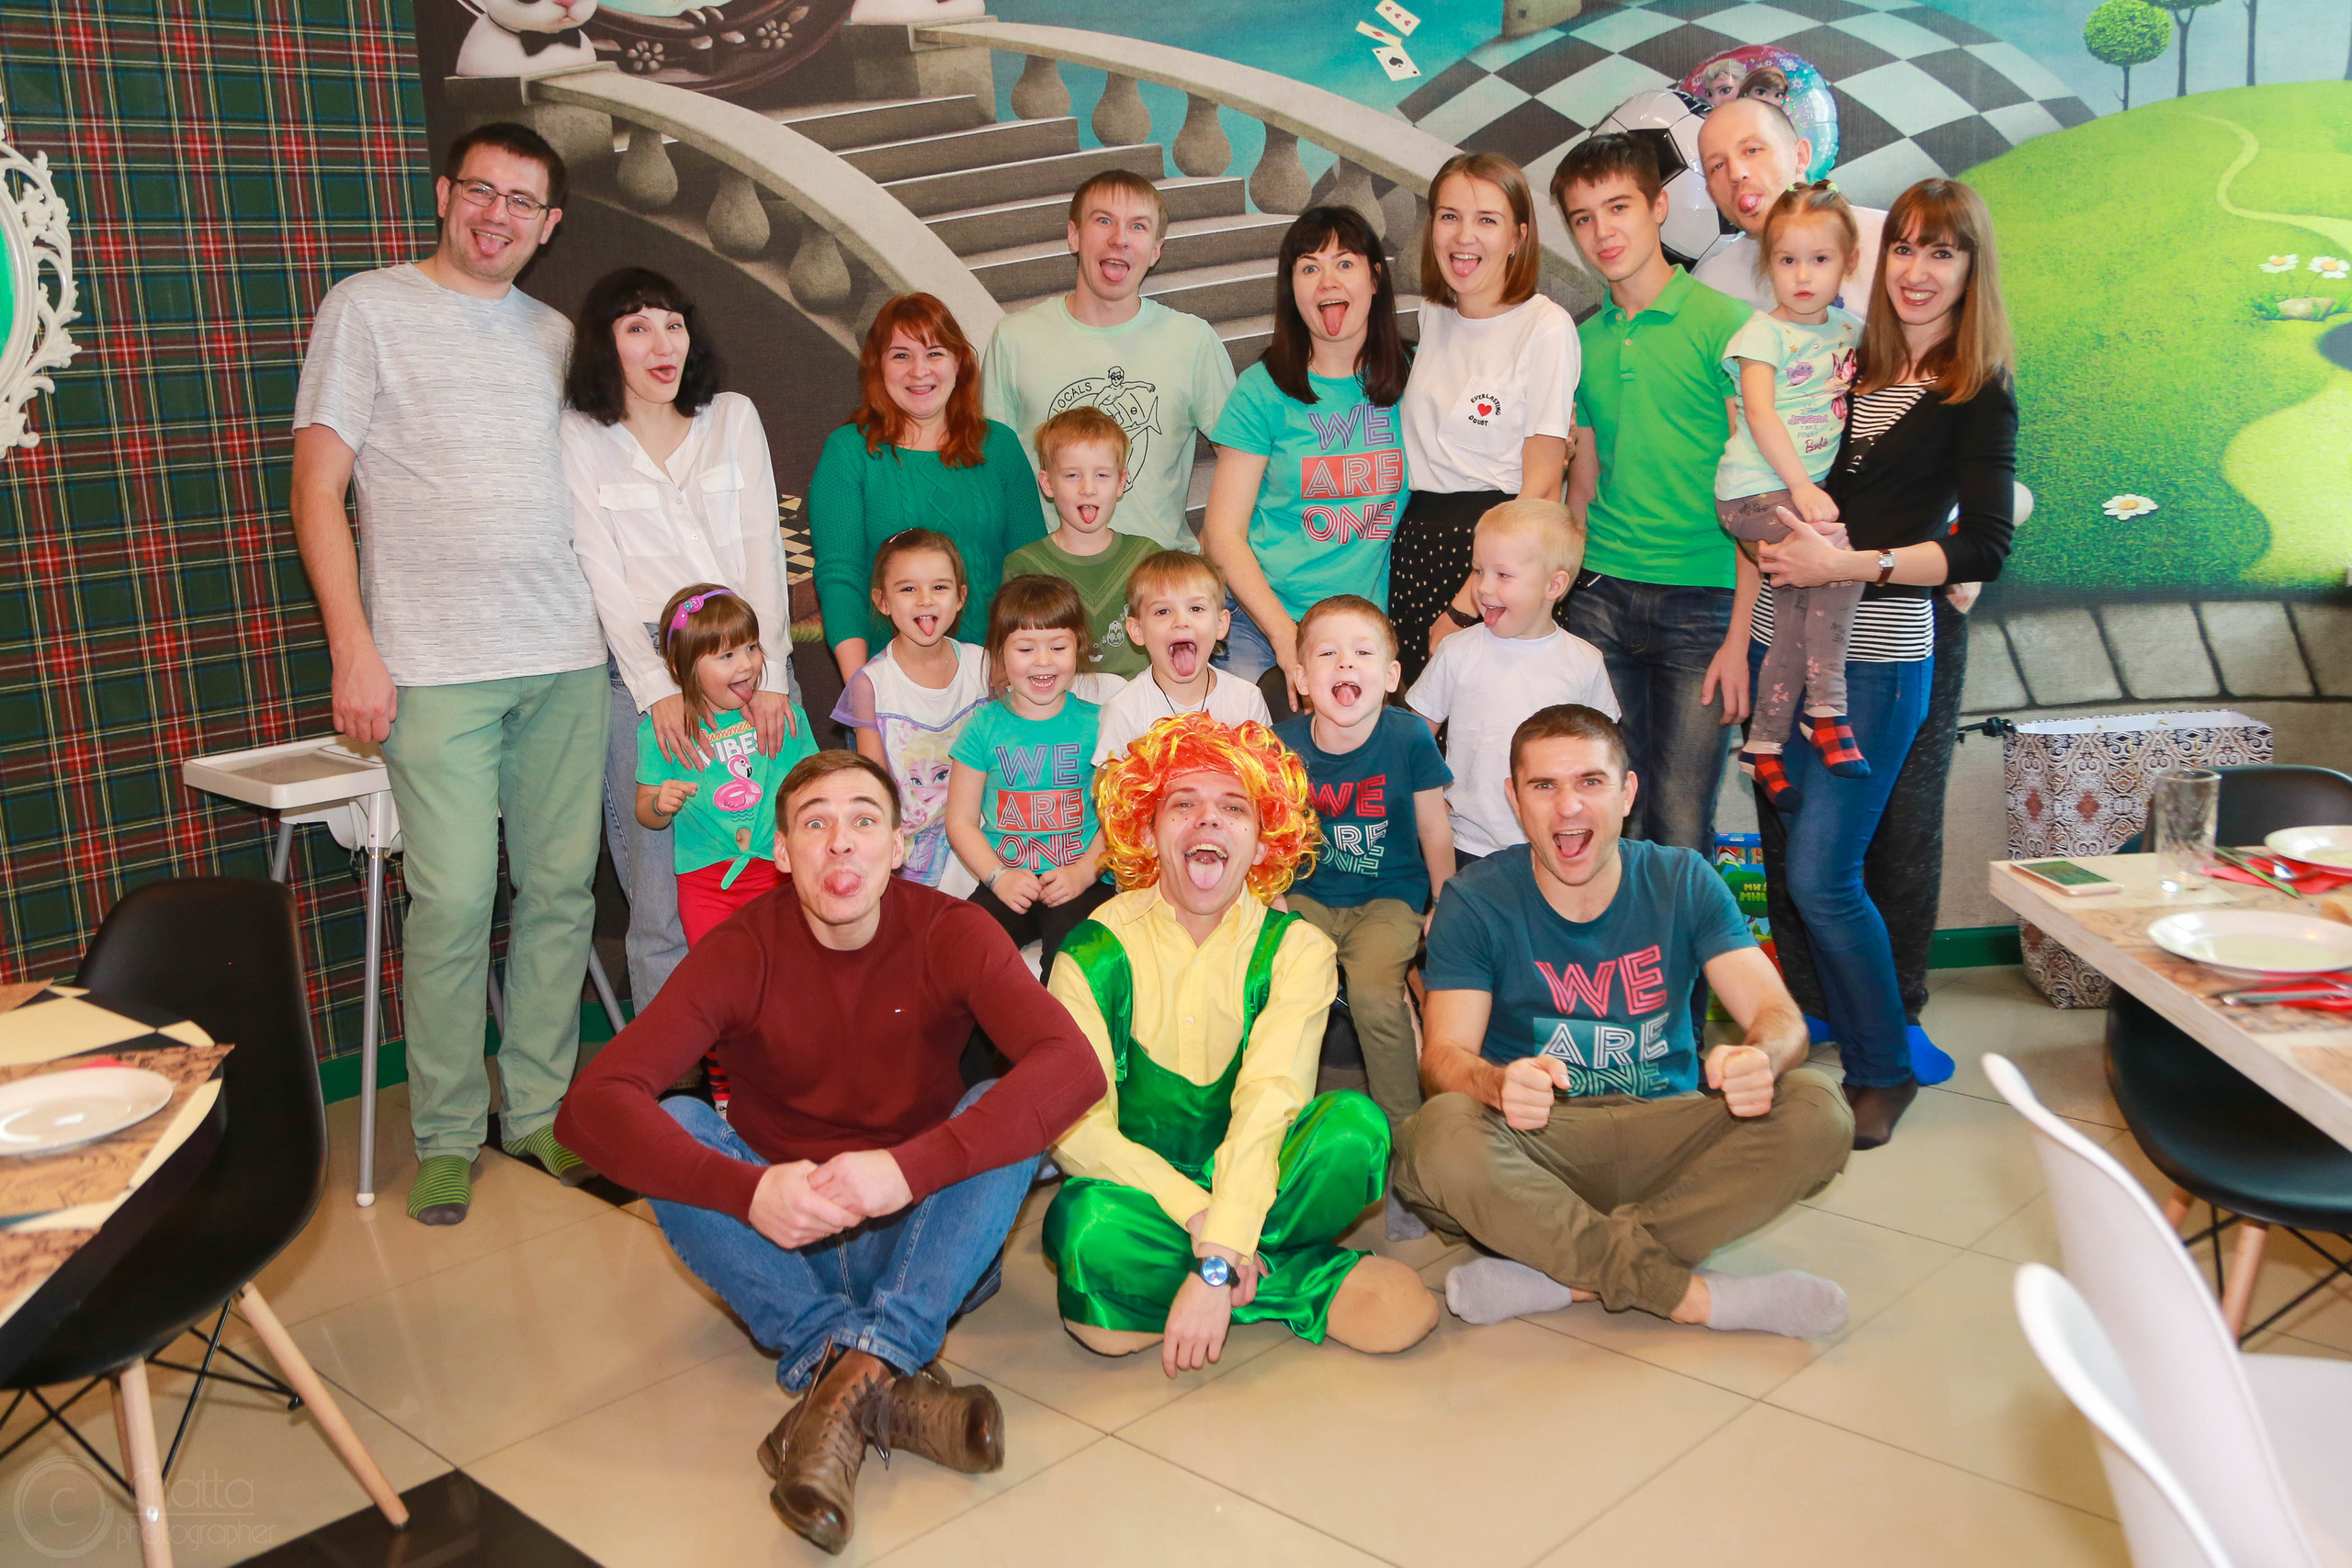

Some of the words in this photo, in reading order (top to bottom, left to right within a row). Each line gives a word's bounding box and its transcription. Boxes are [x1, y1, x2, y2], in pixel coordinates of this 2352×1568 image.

[1052, 381, 1093, 413] LOCALS
[1470, 393, 1501, 416] EVERLASTING
[1308, 403, 1395, 450] WE
[1468, 414, 1488, 426] DOUBT
[1303, 452, 1400, 498] ARE
[1302, 501, 1396, 544] ONE
[995, 743, 1080, 787] WE
[998, 791, 1084, 829] ARE
[1308, 774, 1386, 818] WE
[996, 829, 1086, 870] ONE
[1319, 820, 1389, 856] RE
[1534, 944, 1668, 1018] WE
[1539, 1011, 1670, 1069] ARE
